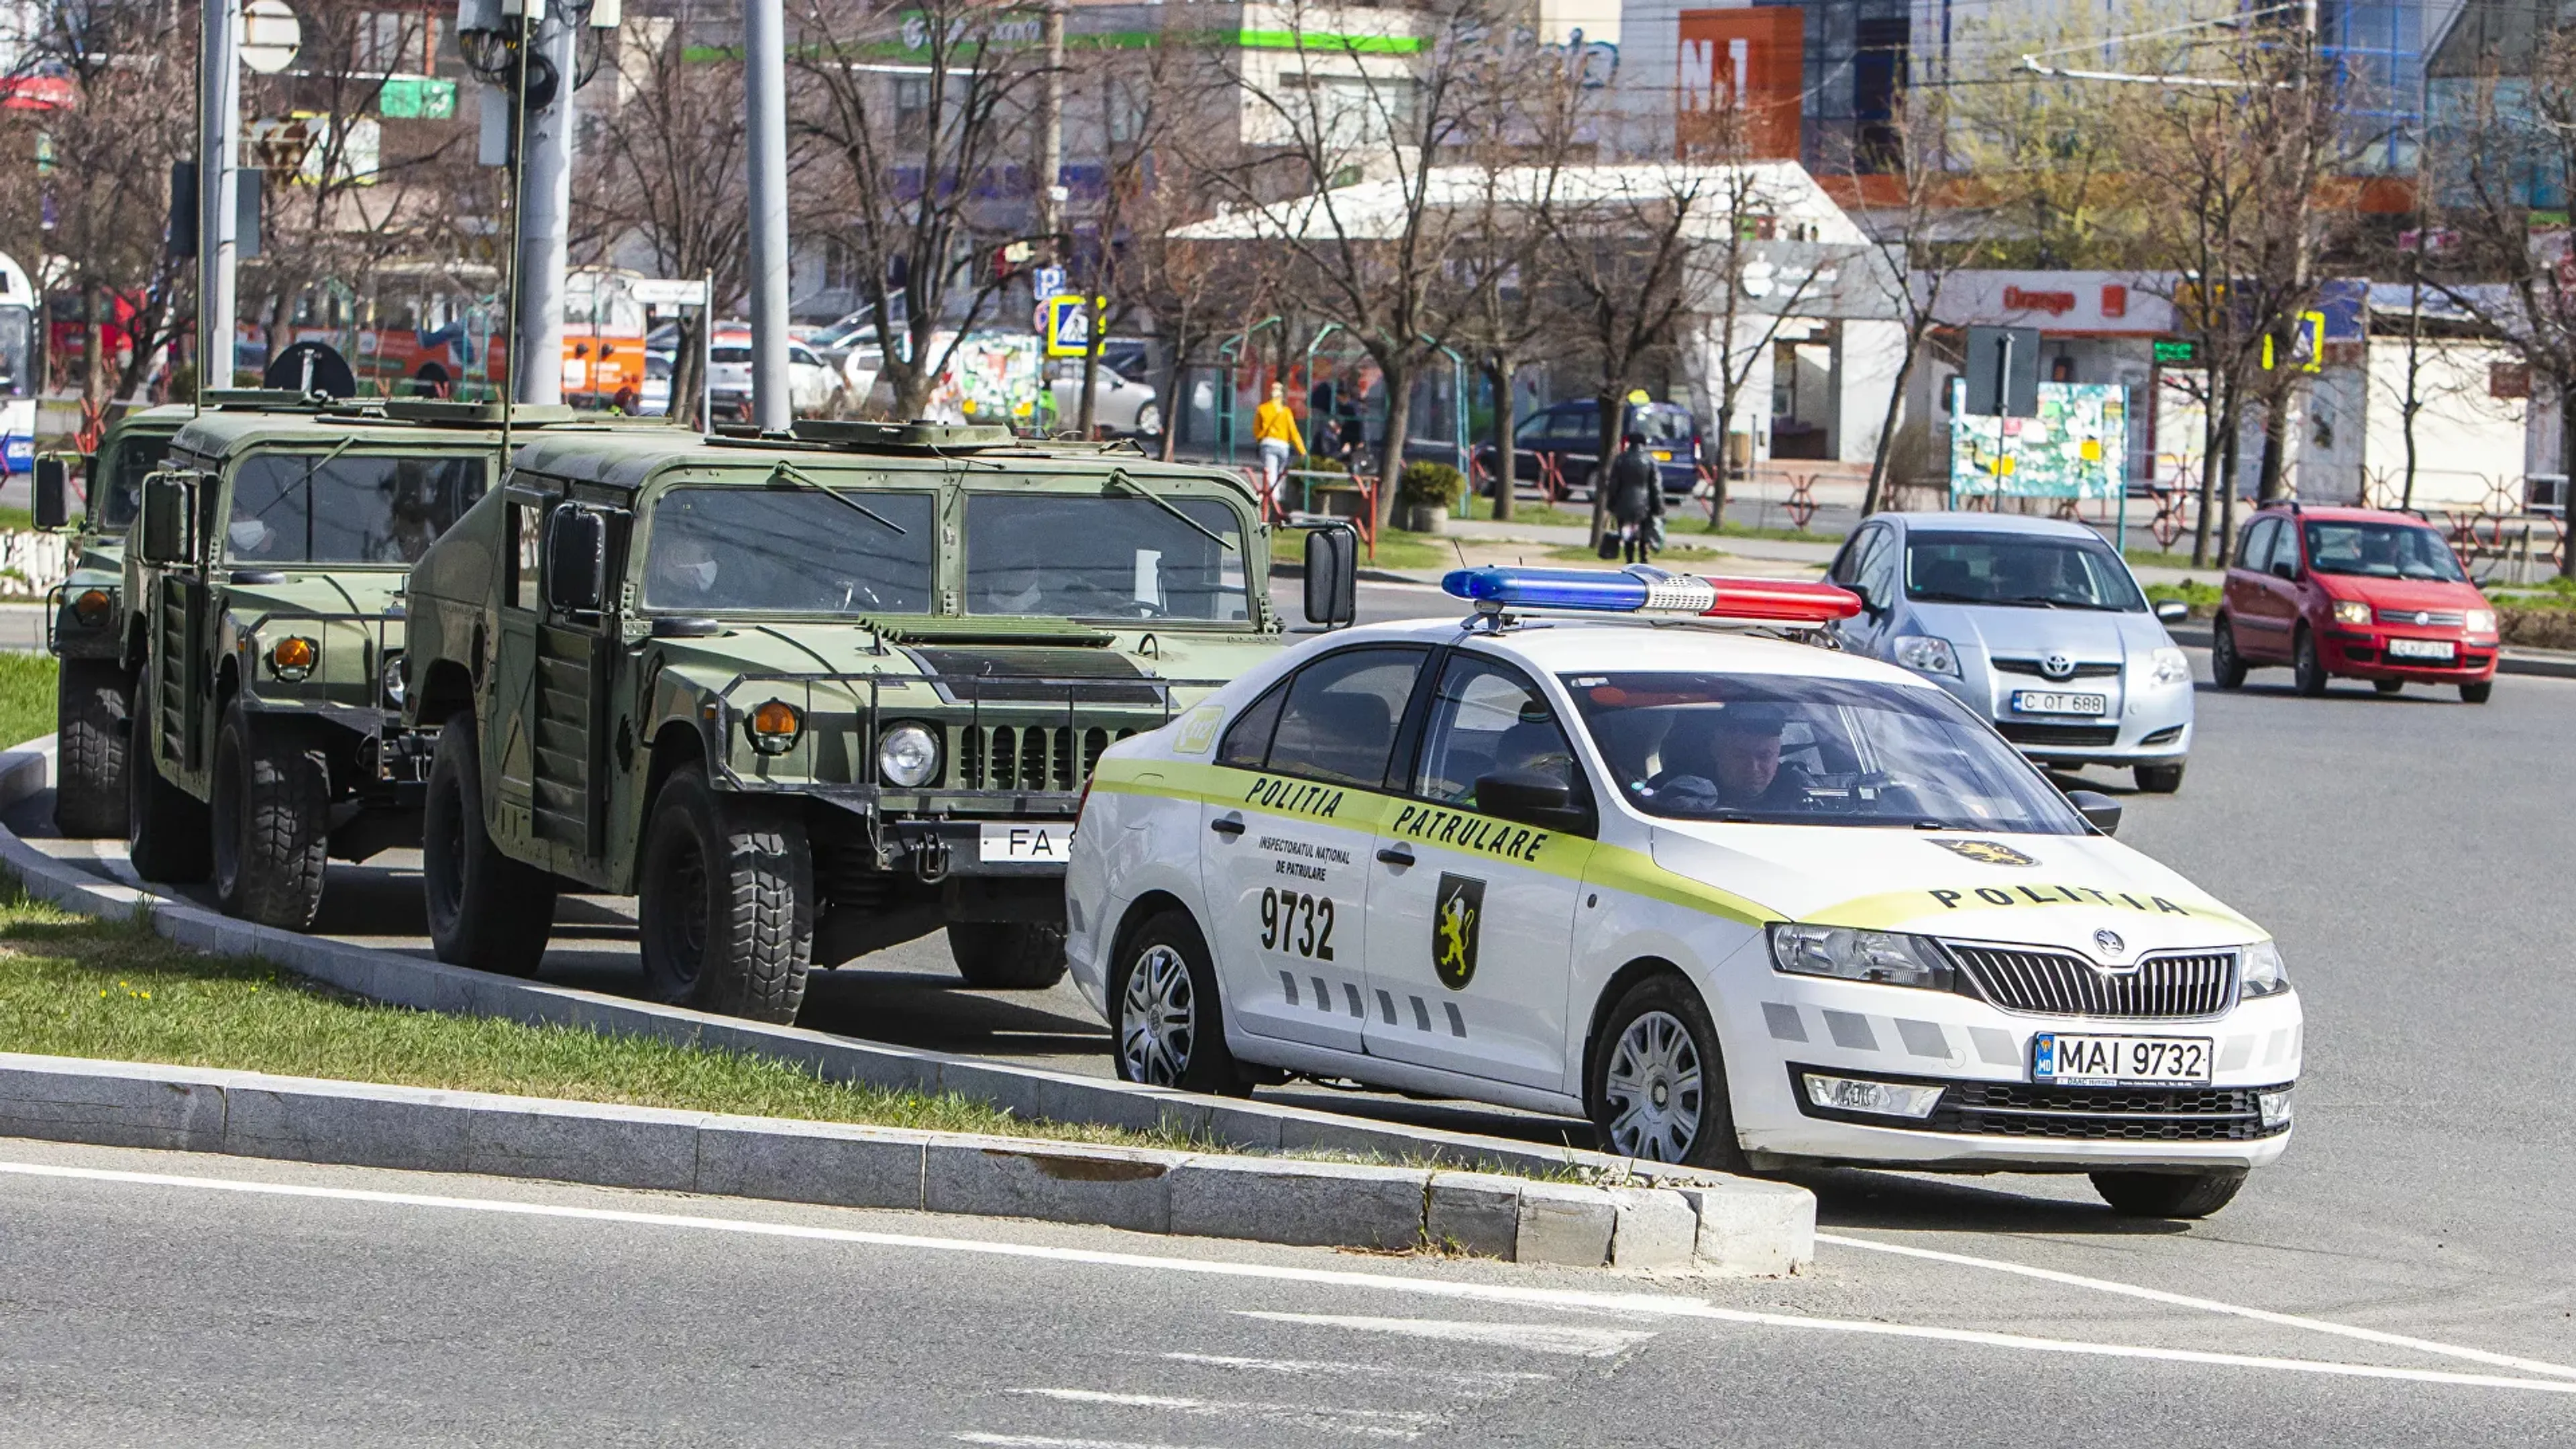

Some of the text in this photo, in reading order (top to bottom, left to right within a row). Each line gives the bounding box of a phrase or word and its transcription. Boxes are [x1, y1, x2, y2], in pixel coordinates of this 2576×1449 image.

[1040, 269, 1061, 295] P
[2004, 285, 2076, 317] Orange
[2025, 694, 2035, 708] C
[2073, 696, 2101, 712] 688
[1010, 829, 1053, 855] FA
[1393, 805, 1548, 861] PATRULARE
[1258, 836, 1313, 858] INSPECTORATUL
[1275, 859, 1327, 881] DE PATRULARE
[1261, 886, 1334, 961] 9732
[2038, 1059, 2051, 1072] MD
[2058, 1040, 2202, 1077] MAI 9732
